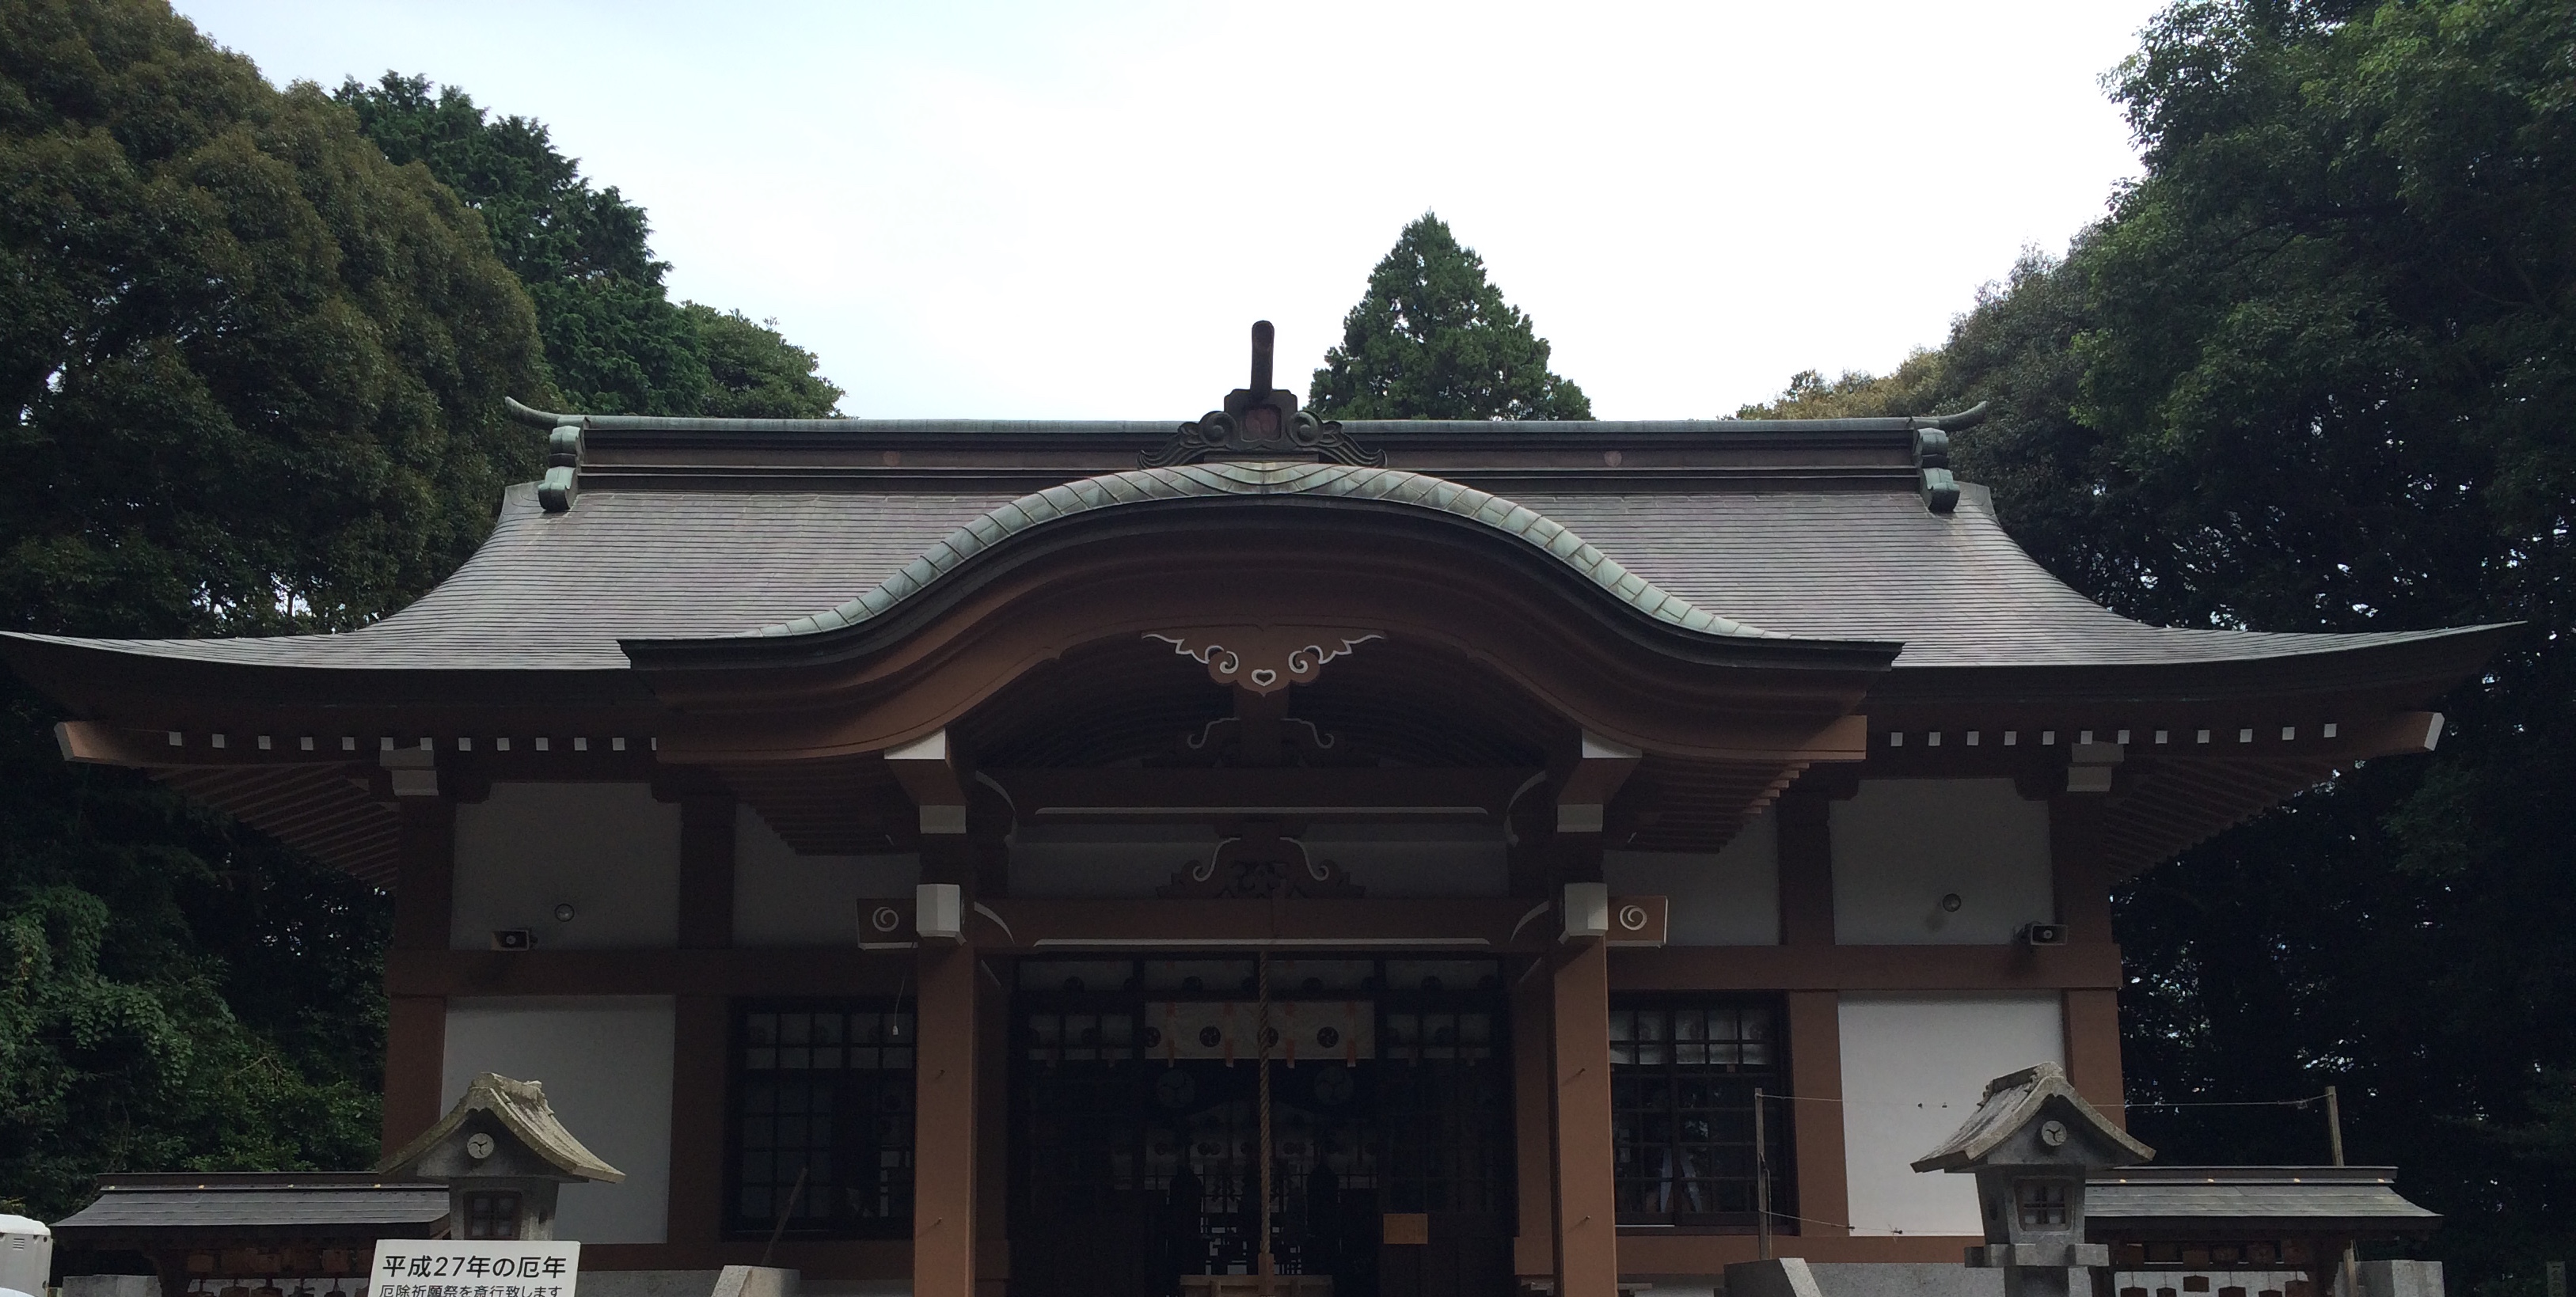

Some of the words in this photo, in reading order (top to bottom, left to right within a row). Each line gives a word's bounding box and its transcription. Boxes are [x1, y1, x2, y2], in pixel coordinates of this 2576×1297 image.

[382, 1255, 567, 1278] 平成27年の厄年
